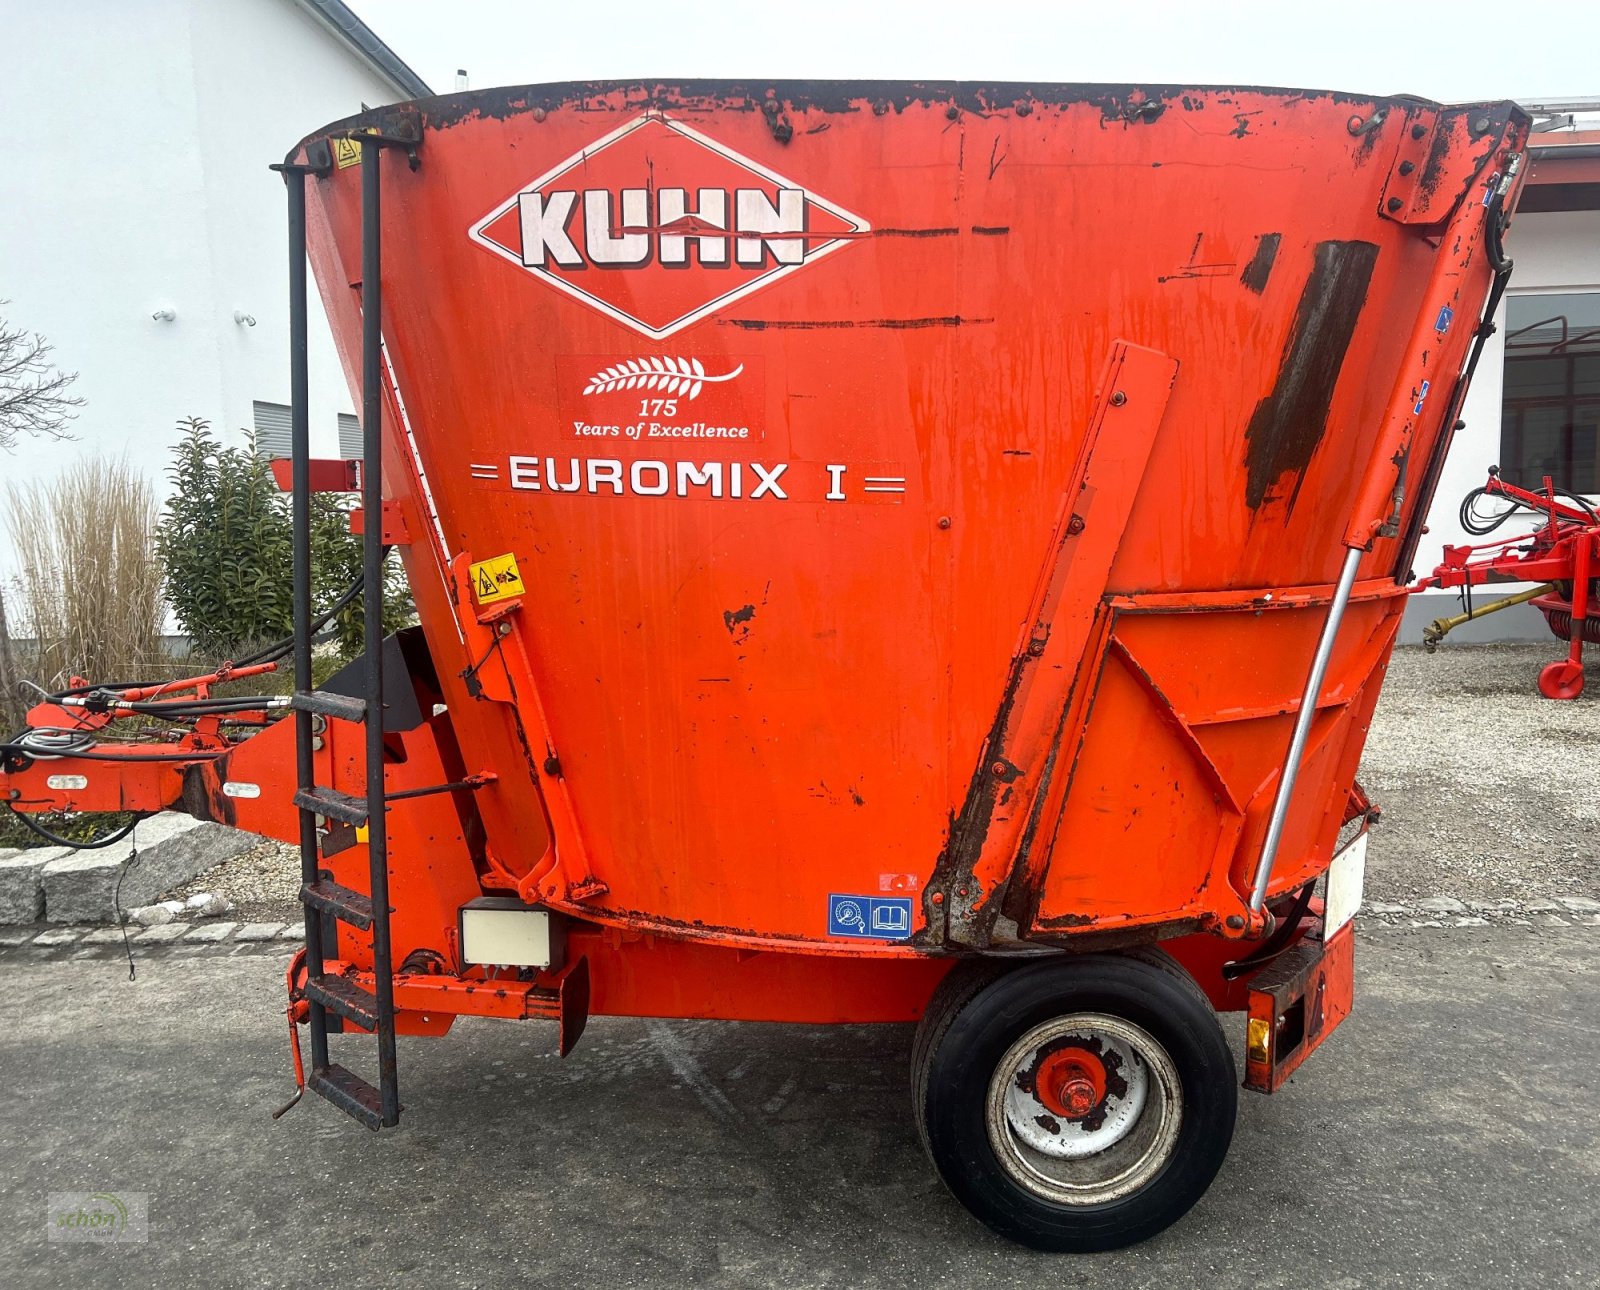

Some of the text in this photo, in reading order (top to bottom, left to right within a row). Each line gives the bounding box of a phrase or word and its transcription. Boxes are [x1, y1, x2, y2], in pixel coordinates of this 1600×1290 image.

[518, 188, 805, 268] KUHN
[638, 399, 678, 417] 175
[573, 421, 749, 440] Years of Excellence
[509, 455, 848, 500] EUROMIX I
